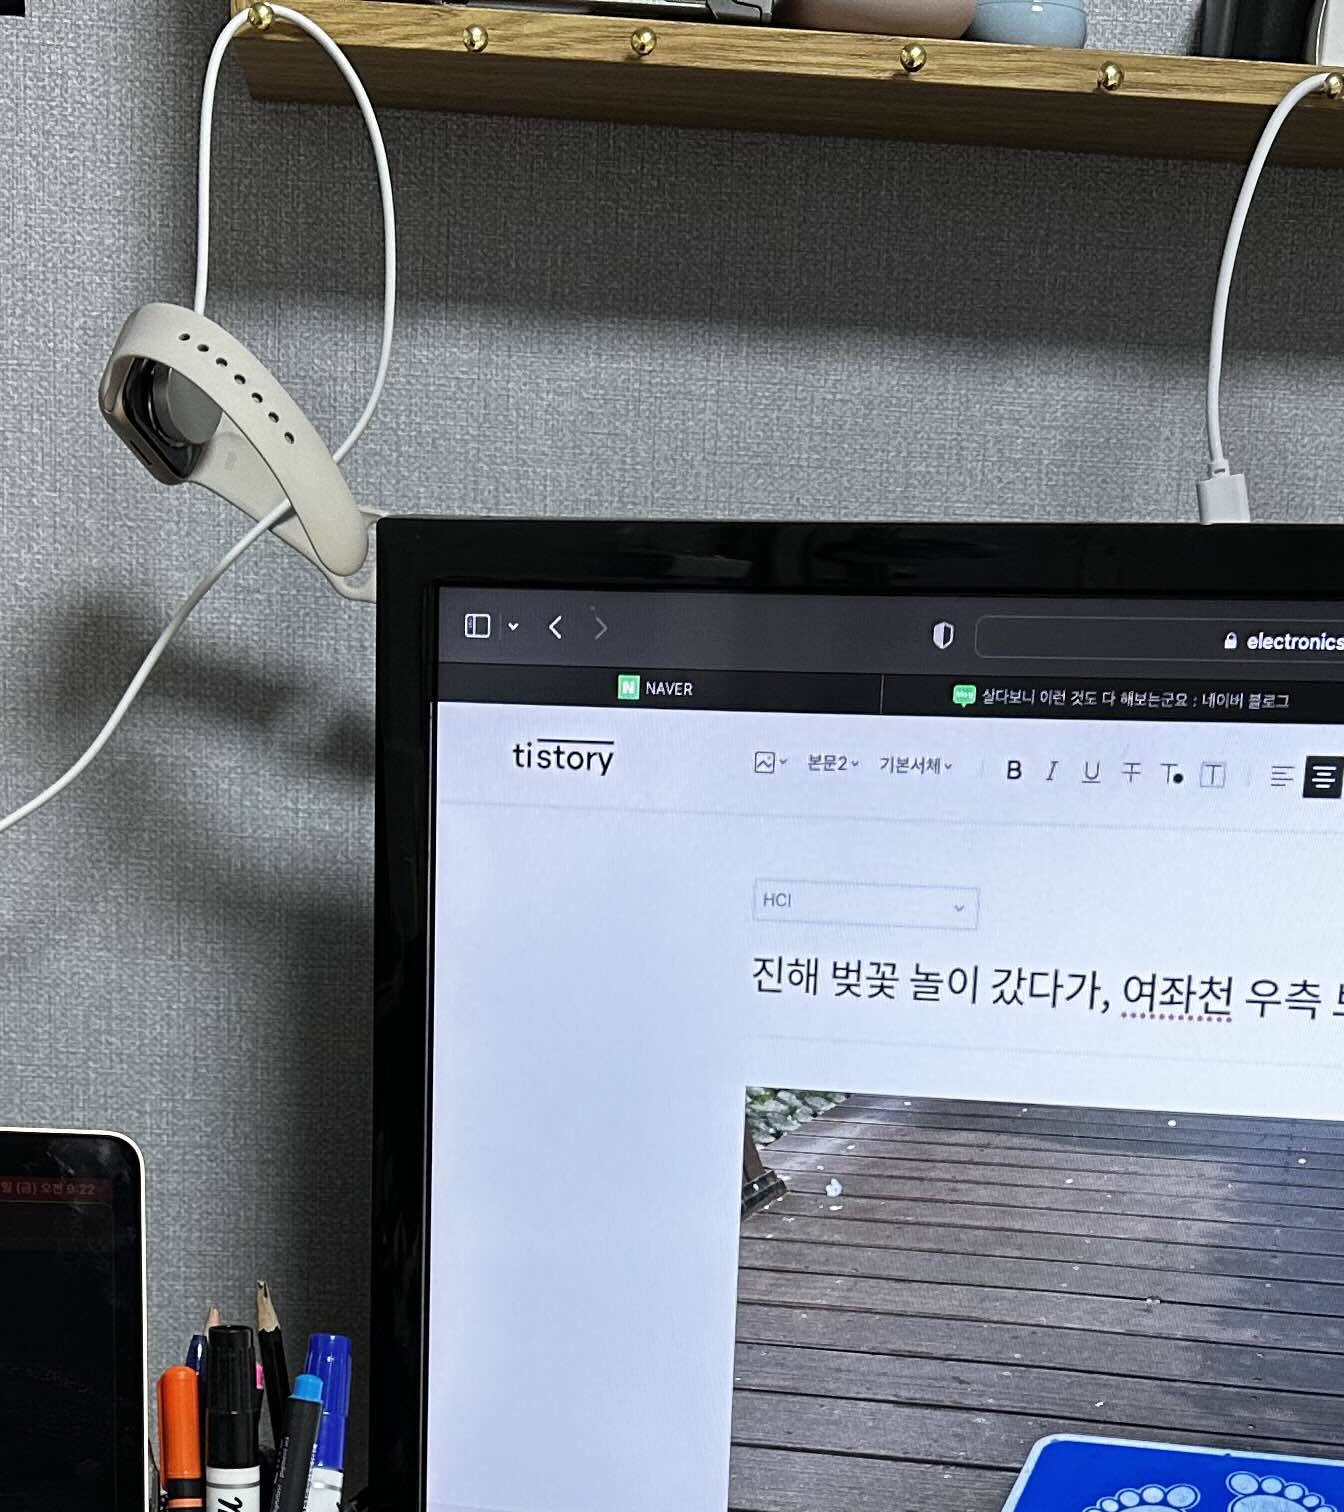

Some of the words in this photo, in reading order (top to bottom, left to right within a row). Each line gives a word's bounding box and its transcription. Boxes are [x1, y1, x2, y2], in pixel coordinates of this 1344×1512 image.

[645, 681, 693, 696] NAVER
[982, 688, 1035, 705] 살다보니
[1040, 689, 1066, 706] 이런
[1071, 690, 1098, 706] 것도
[1102, 692, 1116, 706] 다
[1120, 691, 1189, 708] 해보는군요
[1202, 693, 1243, 710] 네이버
[1248, 694, 1290, 710] 블로그
[512, 740, 614, 777] tistory
[807, 754, 848, 773] 본문2
[880, 756, 942, 775] 기본서체
[1006, 760, 1022, 780] B
[762, 892, 792, 908] HCI
[752, 955, 820, 996] 진해
[831, 957, 899, 1000] 벚꽃
[910, 961, 980, 1005] 놀이
[991, 966, 1112, 1013] 갔다가,
[1122, 972, 1235, 1017] 여좌천
[1244, 978, 1323, 1020] 우측
